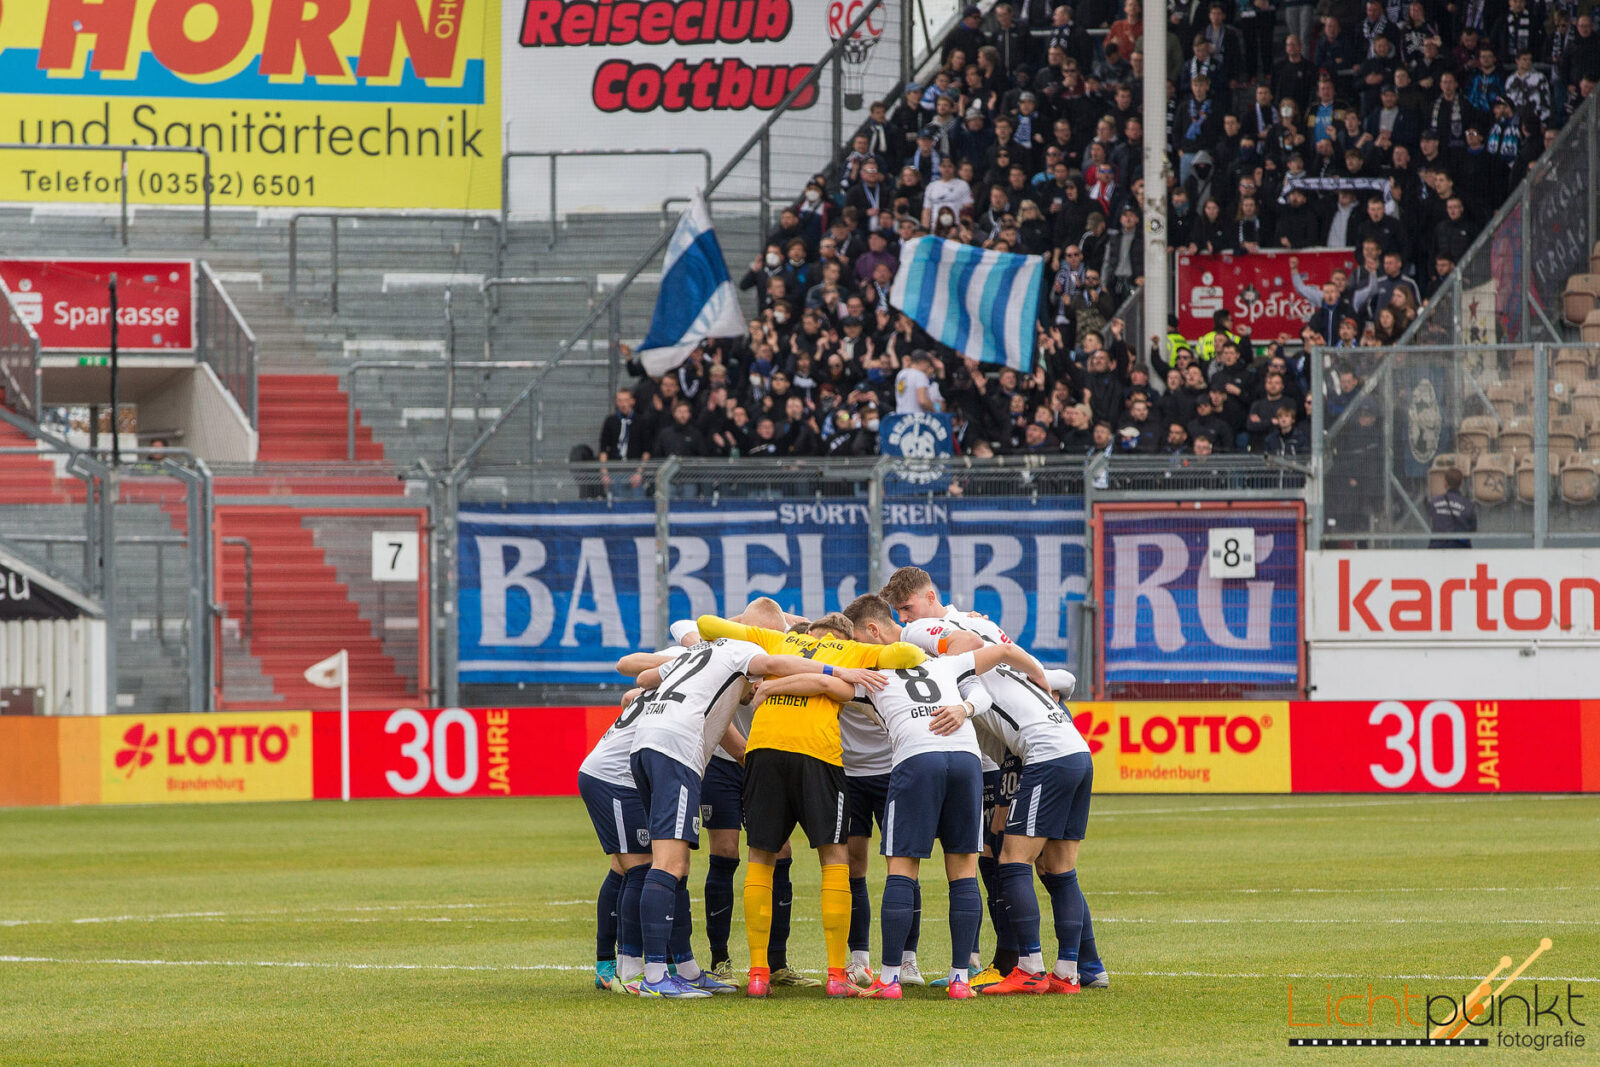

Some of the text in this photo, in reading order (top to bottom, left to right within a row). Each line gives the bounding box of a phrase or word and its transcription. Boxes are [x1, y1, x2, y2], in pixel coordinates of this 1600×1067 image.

[435, 0, 458, 39] OH
[519, 0, 793, 47] Reiseclub
[828, 0, 883, 39] RCC
[37, 0, 466, 79] HORN
[592, 58, 820, 113] Cottbus
[19, 102, 484, 158] und Sanitärtechnik
[253, 174, 316, 197] 6501
[53, 301, 180, 331] Sparkasse
[388, 542, 402, 570] 7
[1224, 538, 1240, 567] 8
[1338, 559, 1600, 632] karton
[895, 666, 942, 704] 8
[384, 707, 511, 795] 30 JAHRE
[1368, 700, 1500, 790] 30 JAHRE
[166, 777, 245, 792] Brandenburg
[1120, 764, 1211, 783] Brandenburg
